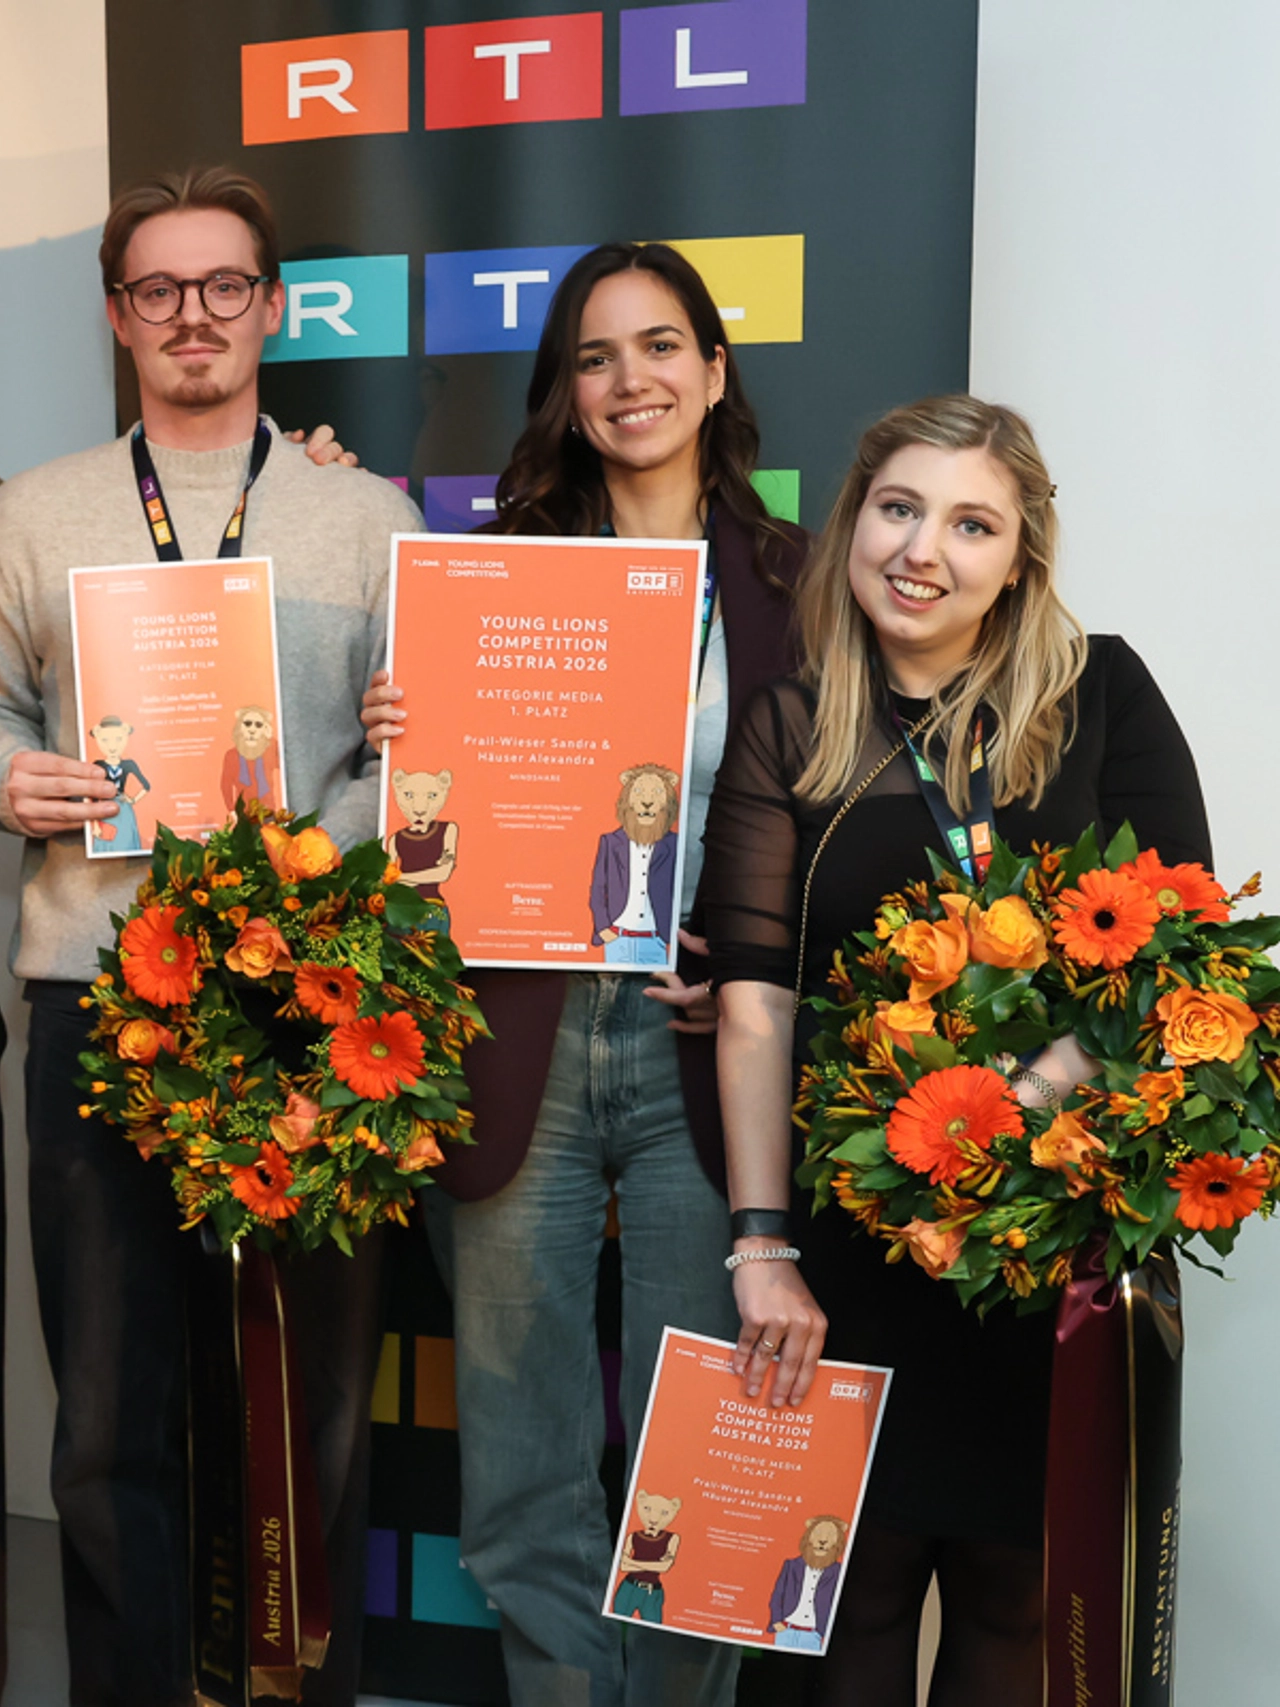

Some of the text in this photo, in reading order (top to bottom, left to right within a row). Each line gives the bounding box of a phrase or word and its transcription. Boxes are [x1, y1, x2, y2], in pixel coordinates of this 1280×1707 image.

[288, 29, 747, 118] RTL
[134, 611, 217, 625] YOUNG LIONS
[481, 616, 609, 633] YOUNG LIONS
[134, 625, 218, 638] COMPETITION
[135, 637, 219, 650] AUSTRIA 2026
[478, 635, 607, 652] COMPETITION
[193, 661, 216, 669] FILM
[476, 655, 608, 671] AUSTRIA 2026
[169, 672, 198, 681] PLATZ
[477, 689, 603, 703] KATEGORIE MEDIA
[511, 706, 568, 718] 1. PLATZ
[551, 738, 597, 750] Sandra
[602, 740, 611, 750] &
[478, 752, 595, 765] Häuser Alexandra
[719, 1399, 814, 1424] YOUNG LIONS
[715, 1412, 811, 1437] COMPETITION
[711, 1425, 809, 1450] AUSTRIA 2026
[708, 1449, 802, 1471] KATEGORIE MEDIA
[743, 1466, 775, 1479] PLATZ
[261, 1516, 282, 1647] Austria 2026
[1151, 1506, 1173, 1677] BESTATTUNG
